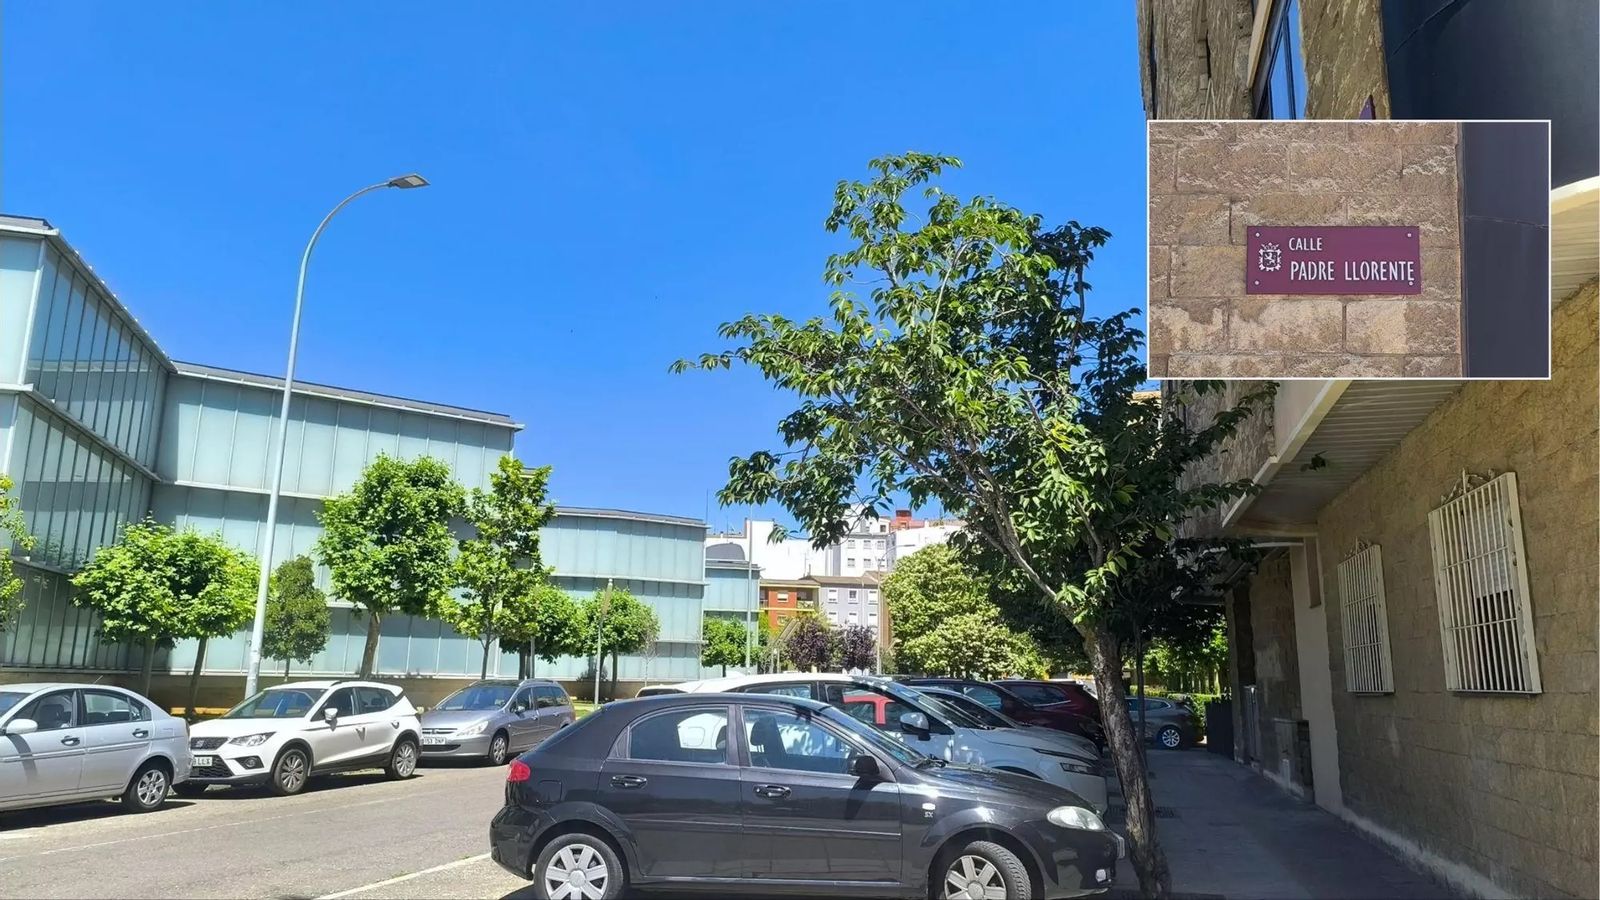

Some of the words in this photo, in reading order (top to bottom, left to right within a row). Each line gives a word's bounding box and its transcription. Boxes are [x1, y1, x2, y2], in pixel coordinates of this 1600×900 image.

[1288, 237, 1323, 251] CALLE
[1290, 261, 1335, 280] PADRE
[1344, 261, 1415, 281] LLORENTE
